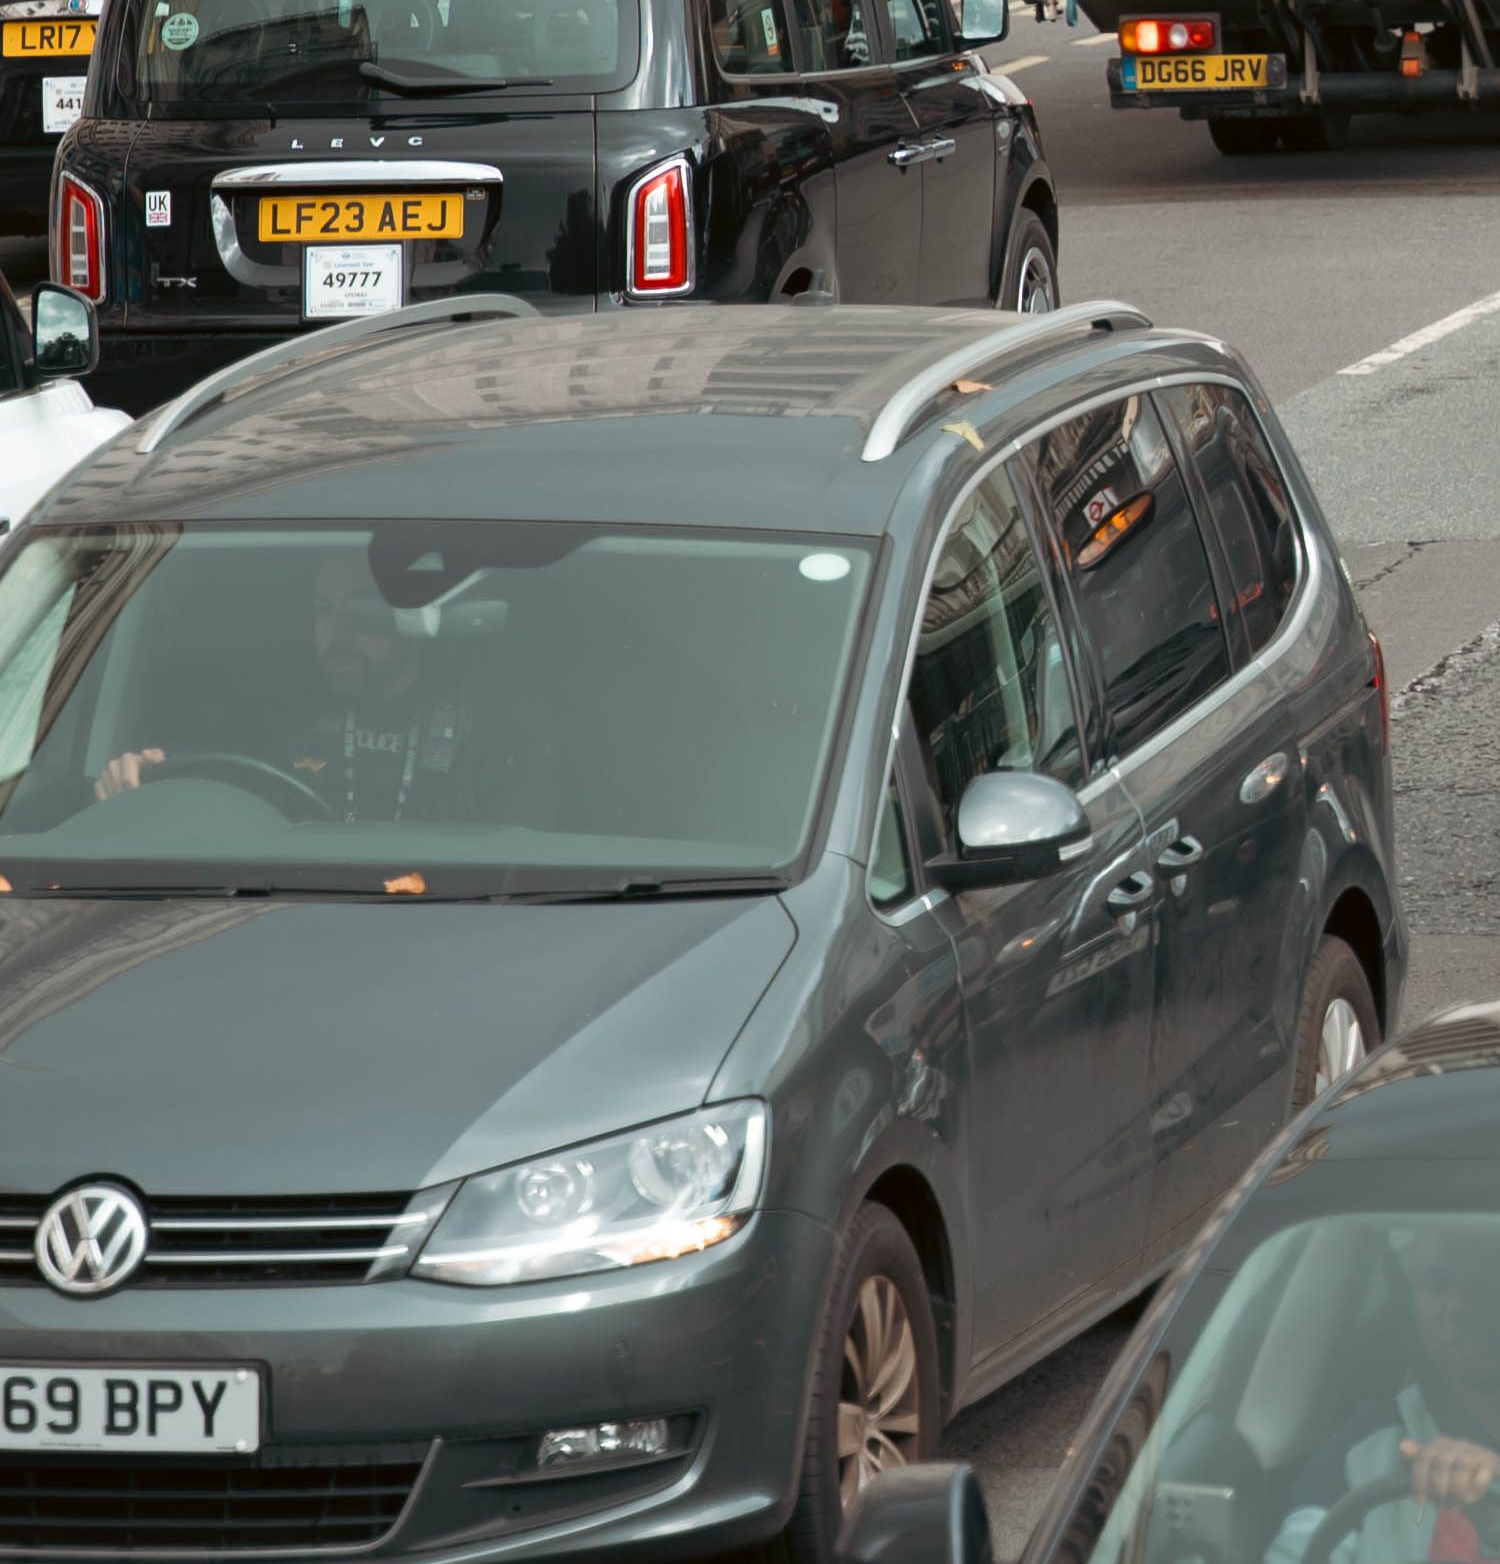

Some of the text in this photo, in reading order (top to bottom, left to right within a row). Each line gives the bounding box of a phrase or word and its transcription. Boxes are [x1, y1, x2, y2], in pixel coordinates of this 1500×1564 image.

[21, 25, 82, 50] LR17
[1140, 58, 1263, 84] DG66 JRV
[56, 97, 82, 110] 441
[291, 136, 423, 150] LEVC
[148, 194, 167, 212] UK
[271, 200, 448, 235] LF23 AEJ
[322, 271, 383, 288] 49777
[103, 1377, 228, 1438] BPY
